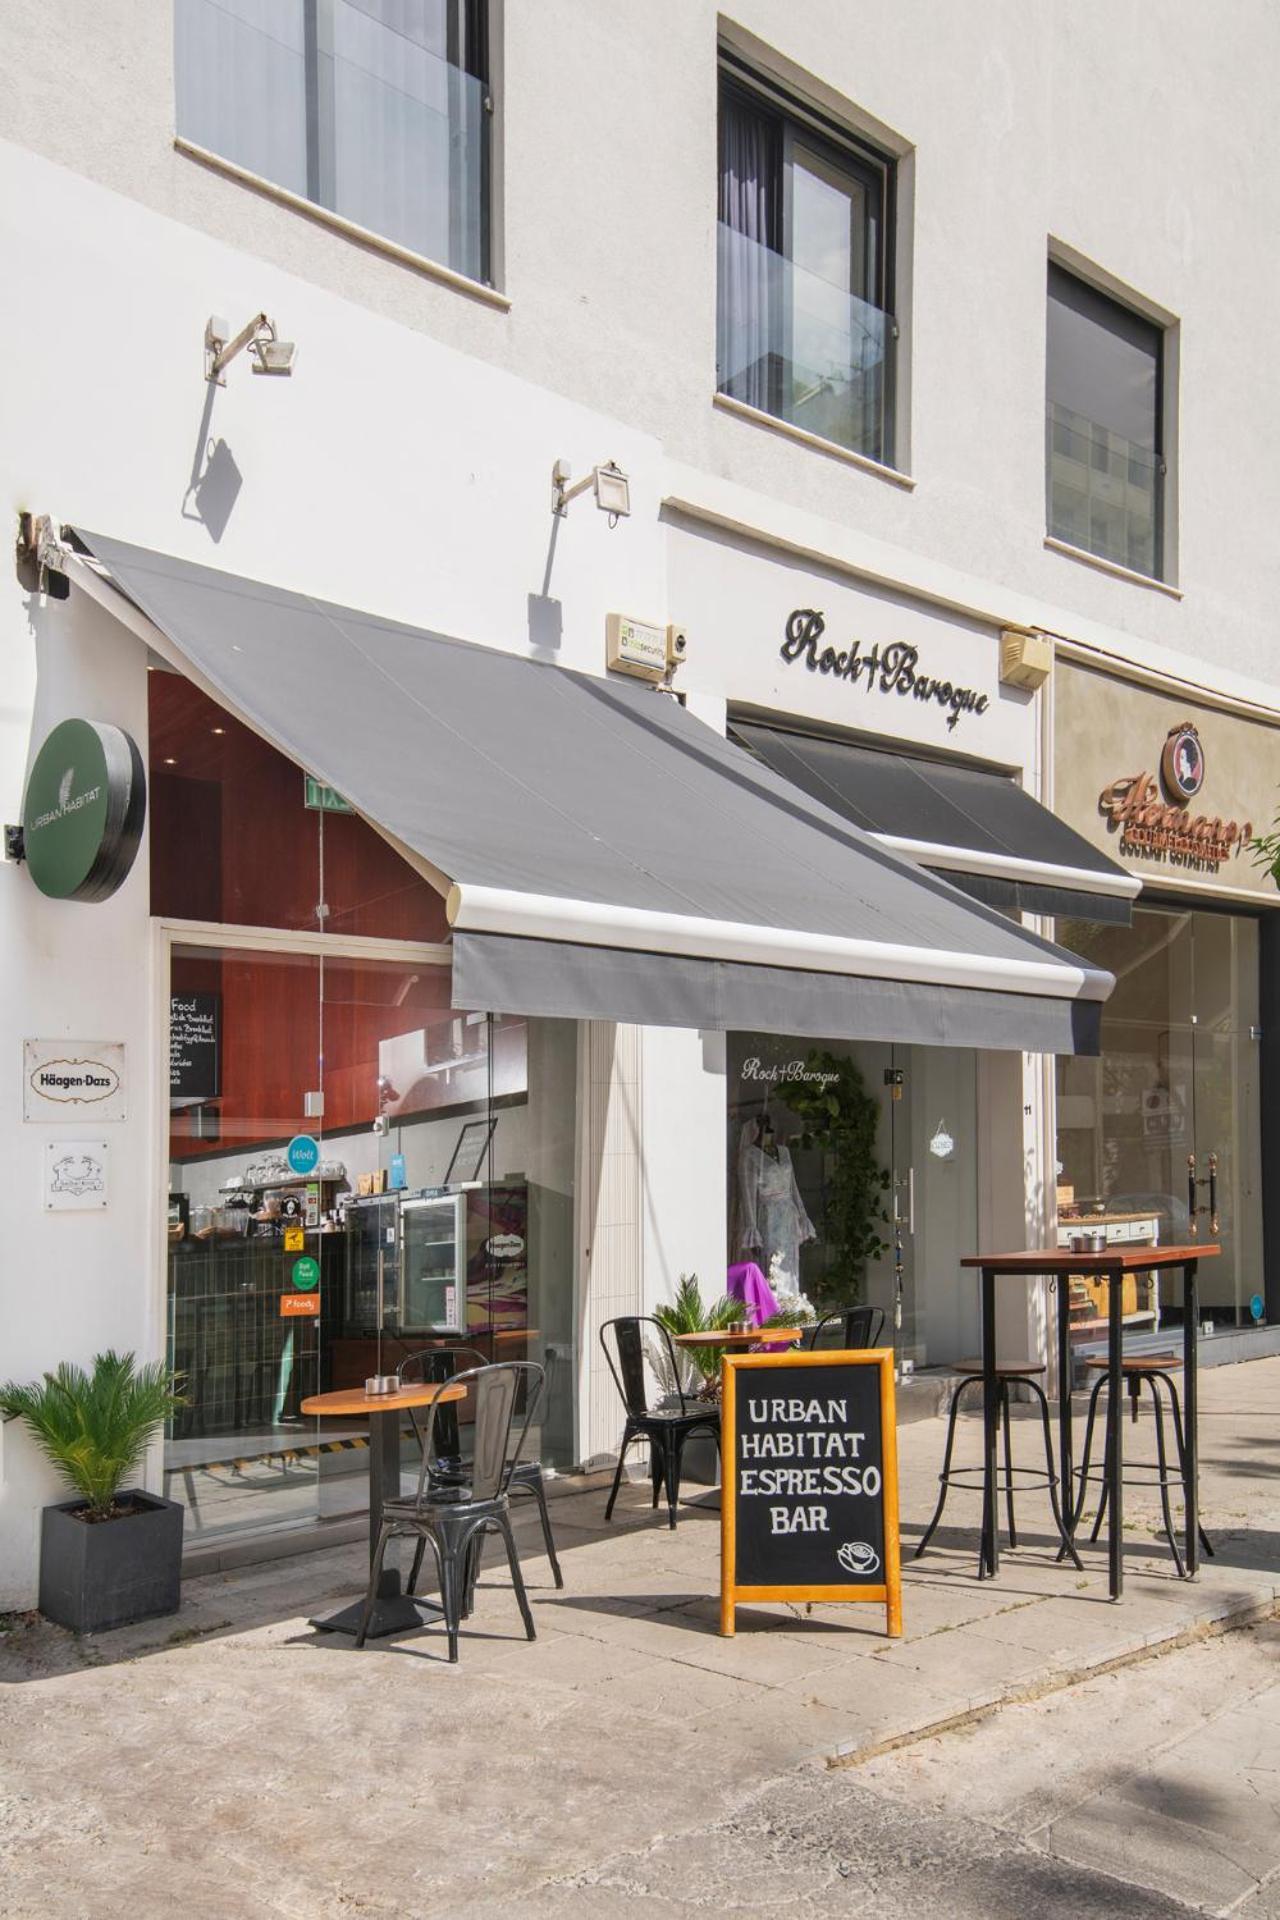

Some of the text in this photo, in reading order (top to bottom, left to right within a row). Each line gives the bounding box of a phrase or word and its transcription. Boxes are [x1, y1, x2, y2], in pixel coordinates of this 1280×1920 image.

[171, 998, 196, 1011] Food
[40, 1073, 111, 1089] Häagen-Dazs
[291, 1148, 314, 1161] Wolt
[748, 1399, 848, 1424] URBAN
[741, 1432, 865, 1459] HABITAT
[740, 1465, 882, 1497] ESPRESSO
[769, 1506, 830, 1535] BAR
